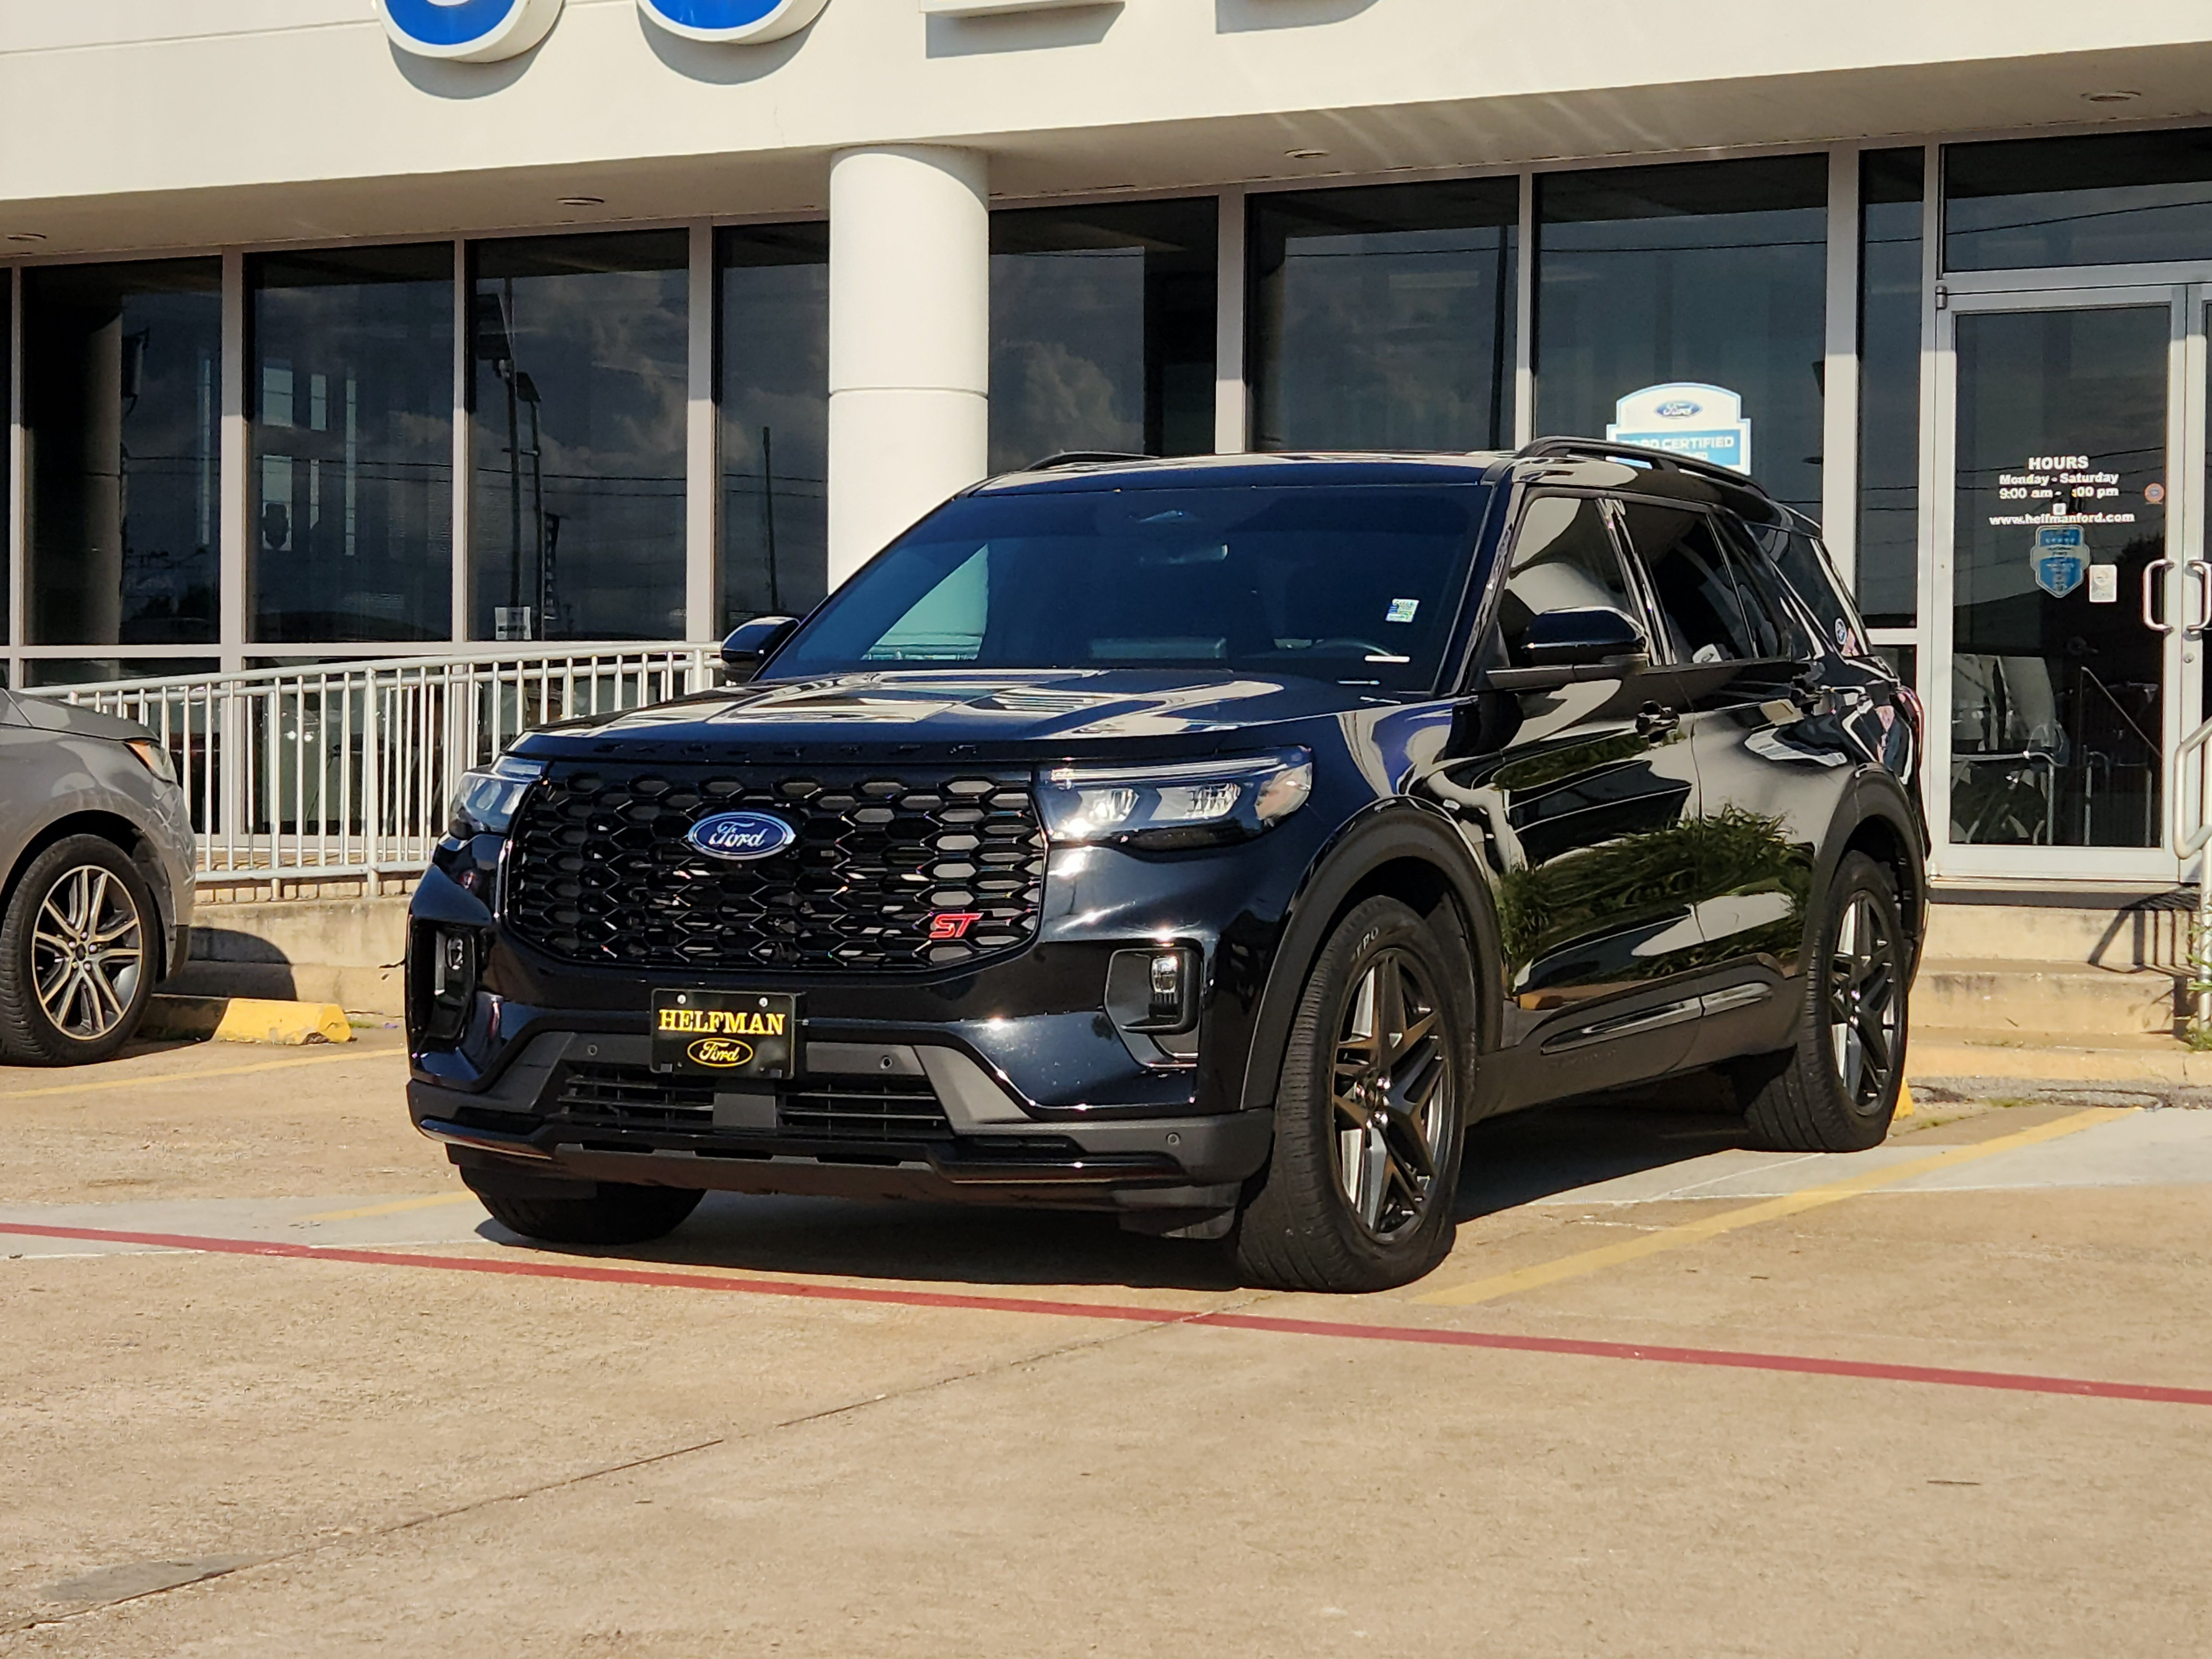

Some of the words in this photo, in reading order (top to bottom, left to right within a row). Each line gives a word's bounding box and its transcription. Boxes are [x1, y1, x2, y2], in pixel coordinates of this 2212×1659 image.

[1662, 402, 1694, 416] Ford
[1662, 436, 1734, 450] CERTIFIED
[2028, 455, 2089, 470] HOURS
[1999, 474, 2050, 486] Monday
[2060, 472, 2119, 484] Saturday
[1999, 488, 2028, 499] 9:00
[2030, 489, 2053, 498] am
[2097, 487, 2119, 499] pm
[1988, 512, 2136, 525] www.helfmanford.com
[709, 821, 769, 848] Ford
[929, 912, 983, 939] ST
[658, 1009, 786, 1035] HELFMAN
[699, 1041, 741, 1061] Ford
